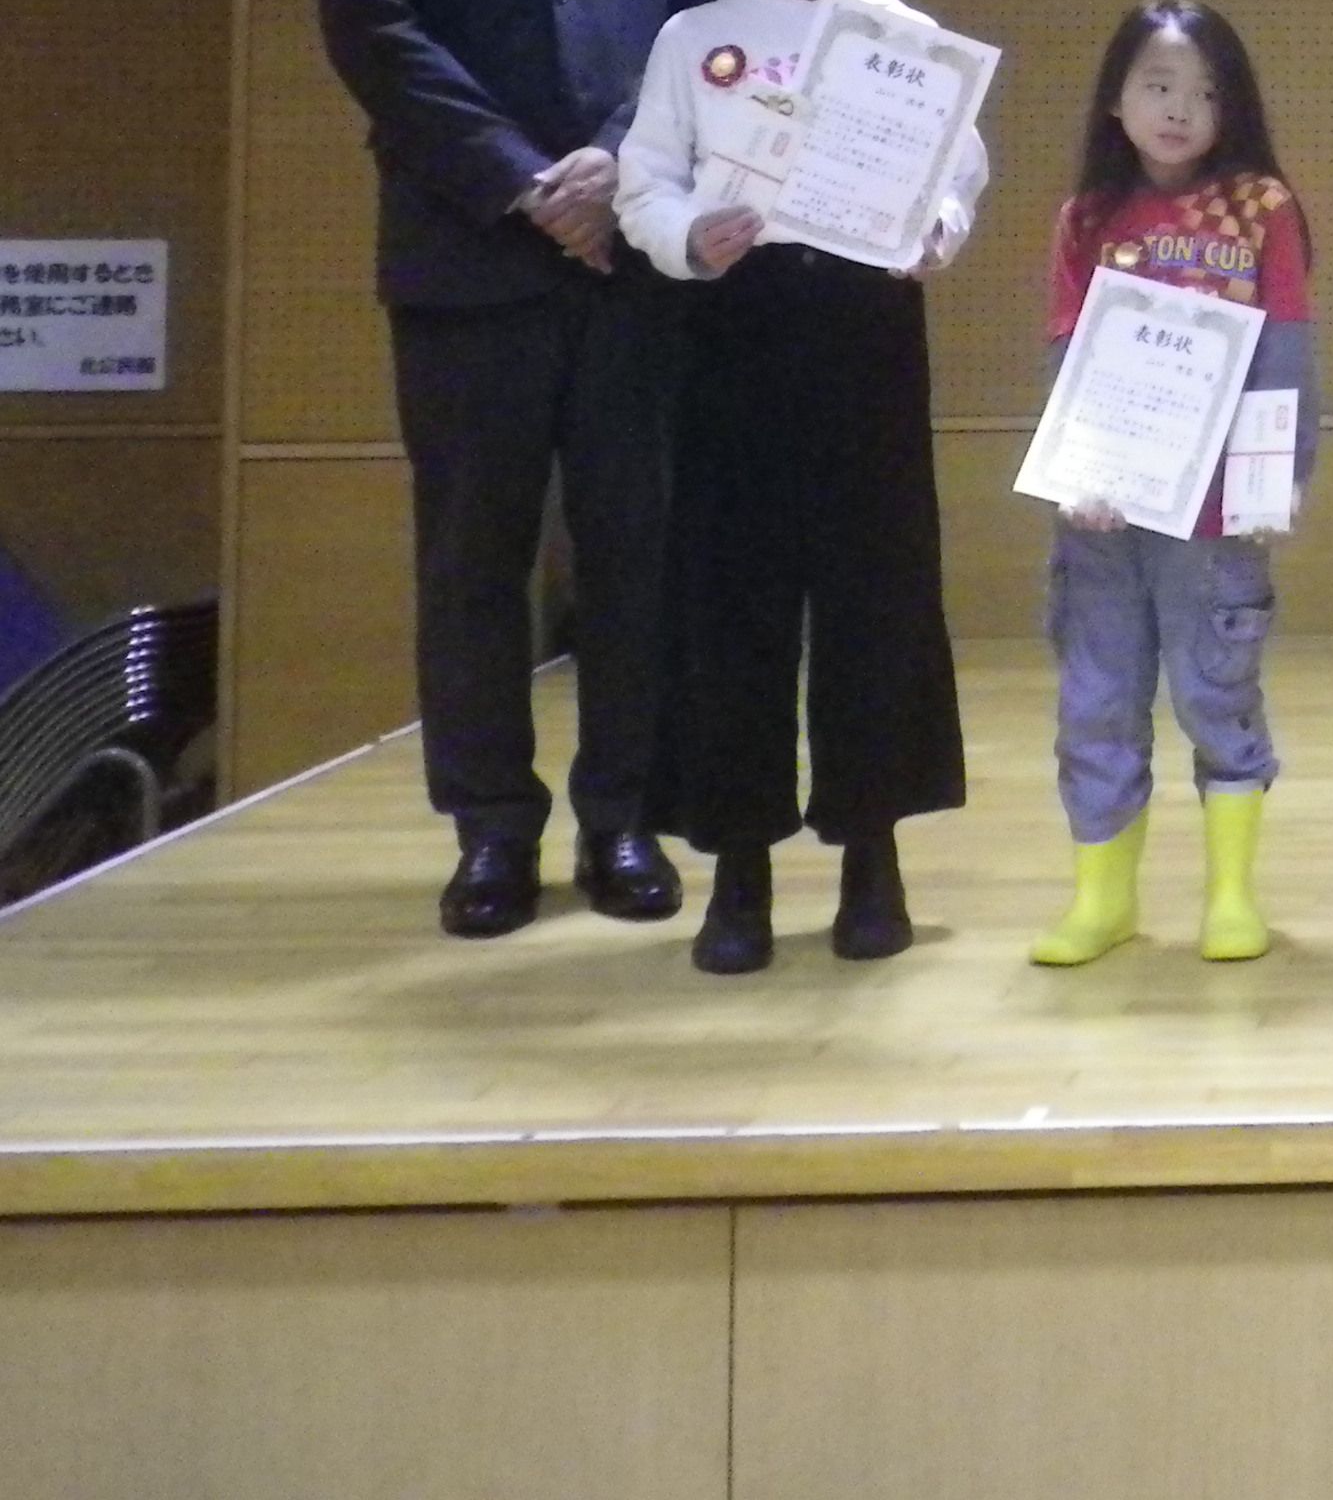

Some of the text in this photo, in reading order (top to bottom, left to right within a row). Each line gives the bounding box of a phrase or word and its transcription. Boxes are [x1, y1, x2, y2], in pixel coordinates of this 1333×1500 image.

[864, 53, 926, 88] 表彰状
[1204, 241, 1255, 272] CUP
[1134, 325, 1193, 356] 表彰状
